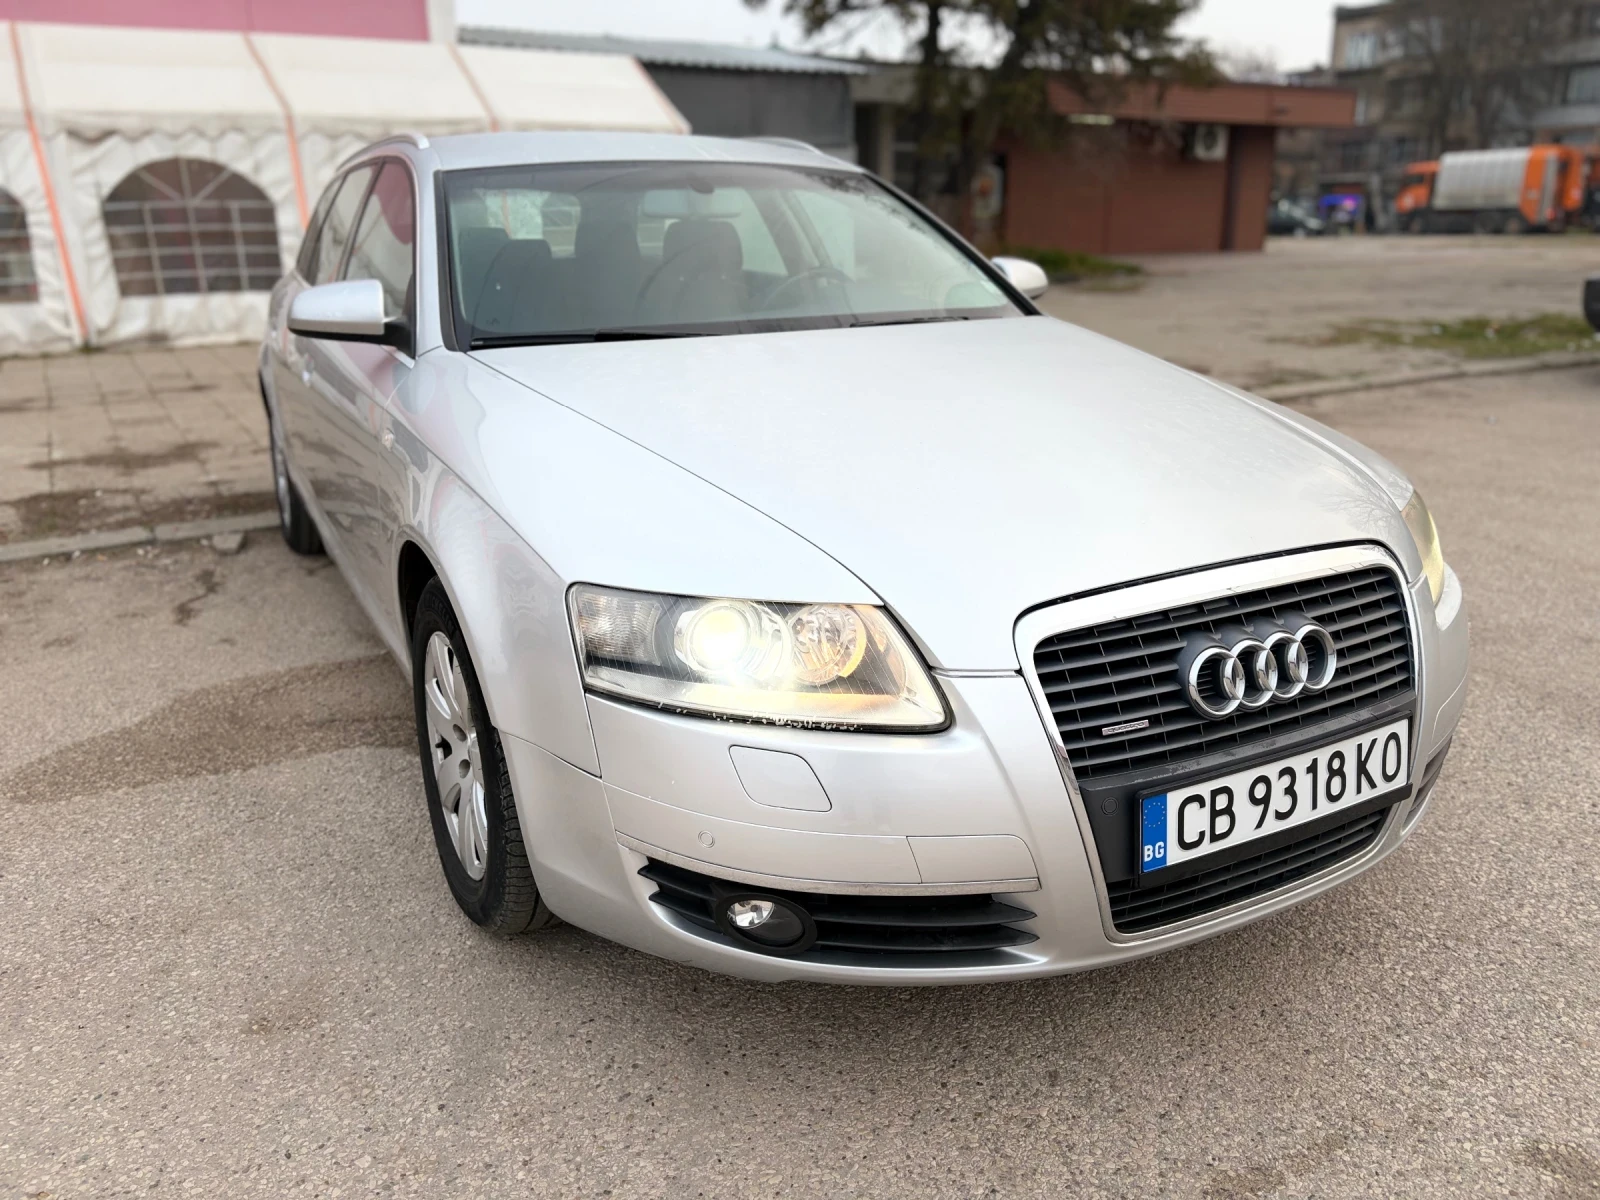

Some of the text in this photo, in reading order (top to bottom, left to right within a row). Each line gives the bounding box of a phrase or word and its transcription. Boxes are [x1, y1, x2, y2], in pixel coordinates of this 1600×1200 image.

[1178, 731, 1402, 851] CB 9318 KO
[1144, 841, 1165, 863] BG
